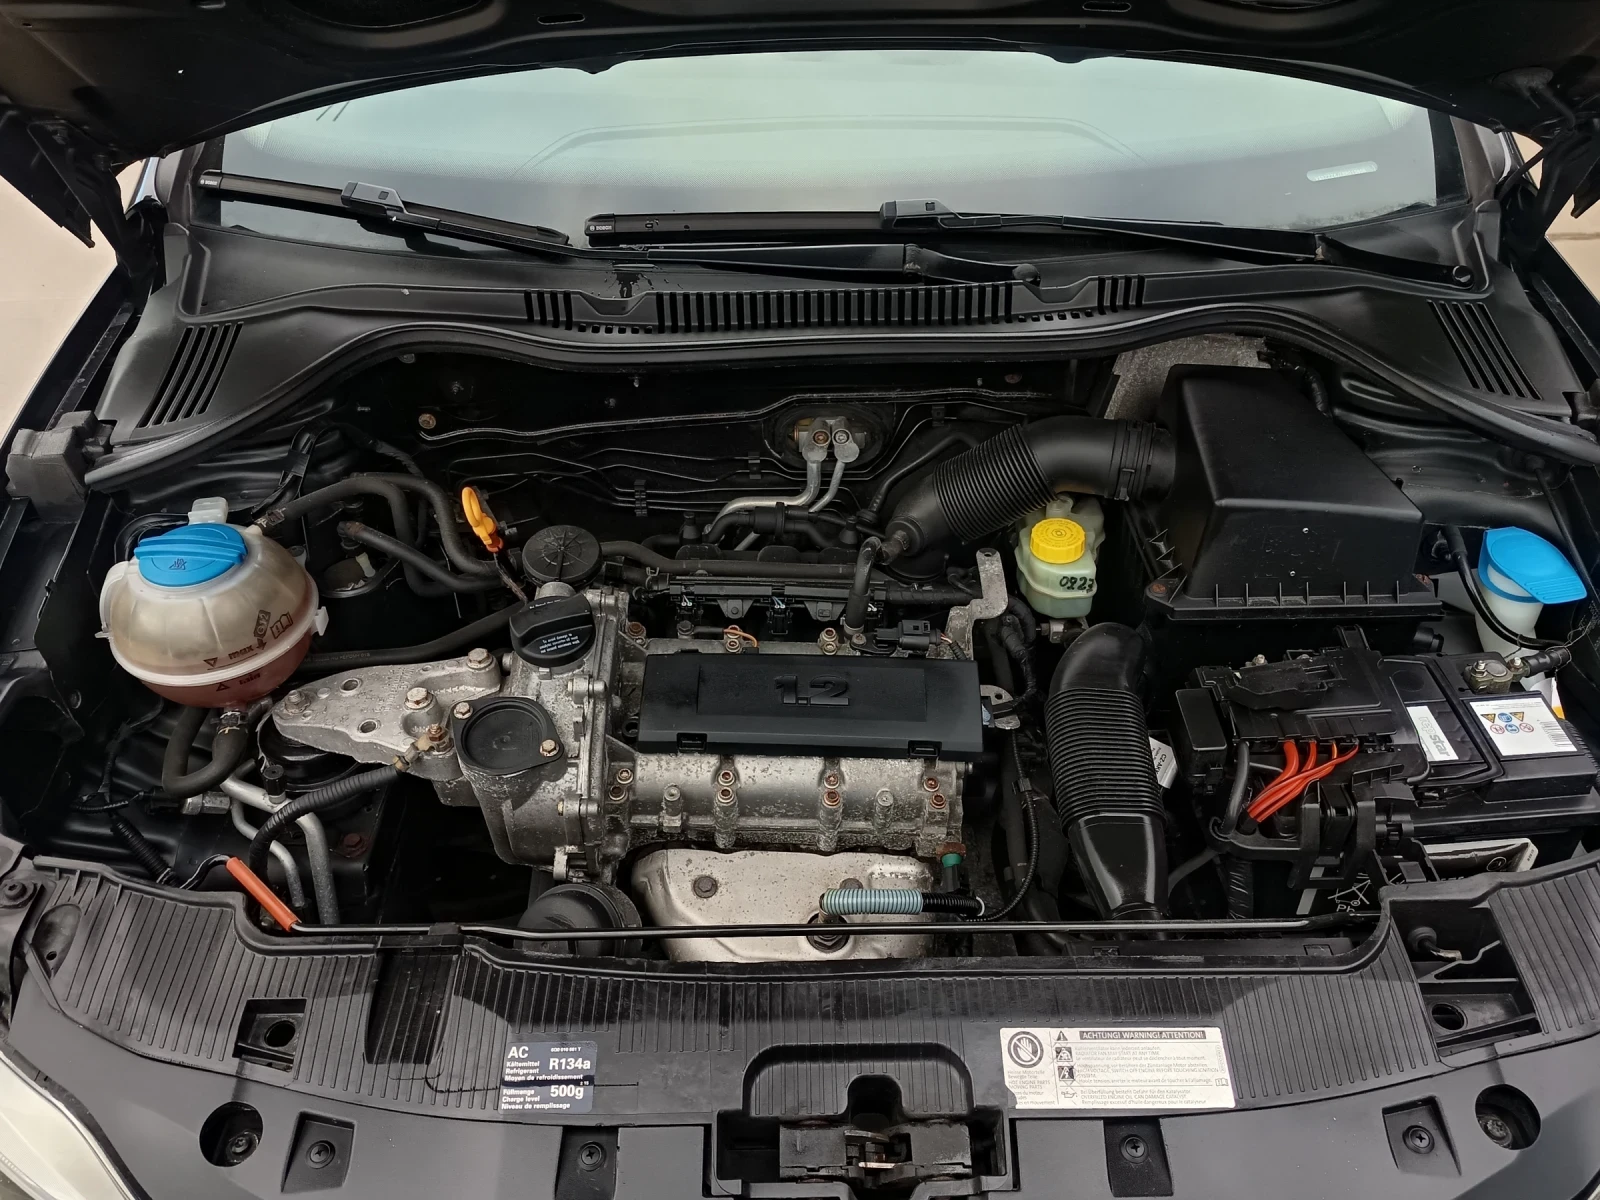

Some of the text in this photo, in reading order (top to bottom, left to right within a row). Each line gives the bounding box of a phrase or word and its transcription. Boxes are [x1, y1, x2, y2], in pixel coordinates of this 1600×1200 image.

[774, 674, 849, 706] 1.2
[1083, 1031, 1203, 1039] ACHTUNG! WARNING! ATTENTION!
[508, 1046, 529, 1059] AC
[549, 1057, 591, 1070] R134a
[550, 1084, 584, 1100] 500g
